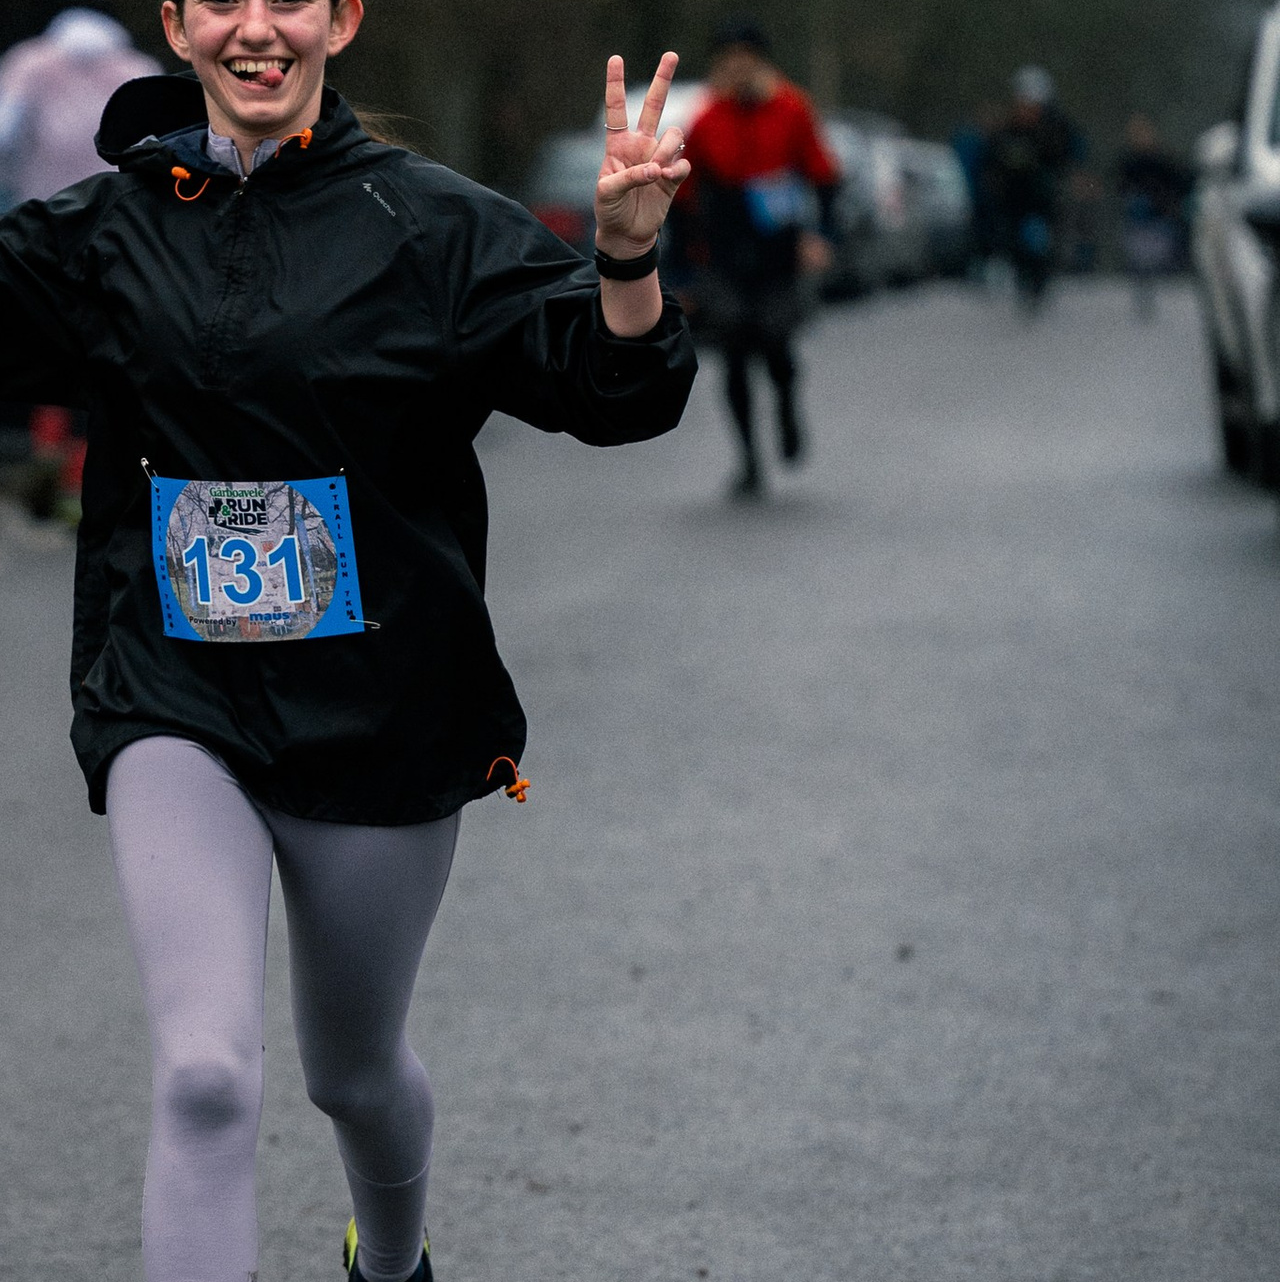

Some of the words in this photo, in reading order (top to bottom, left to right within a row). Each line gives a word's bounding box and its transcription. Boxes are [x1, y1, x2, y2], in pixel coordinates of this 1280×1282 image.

[221, 504, 231, 516] &
[226, 498, 267, 512] RUN
[227, 512, 268, 525] RIDE
[332, 494, 343, 539] TRAIL
[339, 552, 349, 578] RUN
[182, 535, 306, 605] 131
[189, 615, 224, 625] Powered
[226, 617, 237, 627] by
[249, 612, 290, 621] maus
